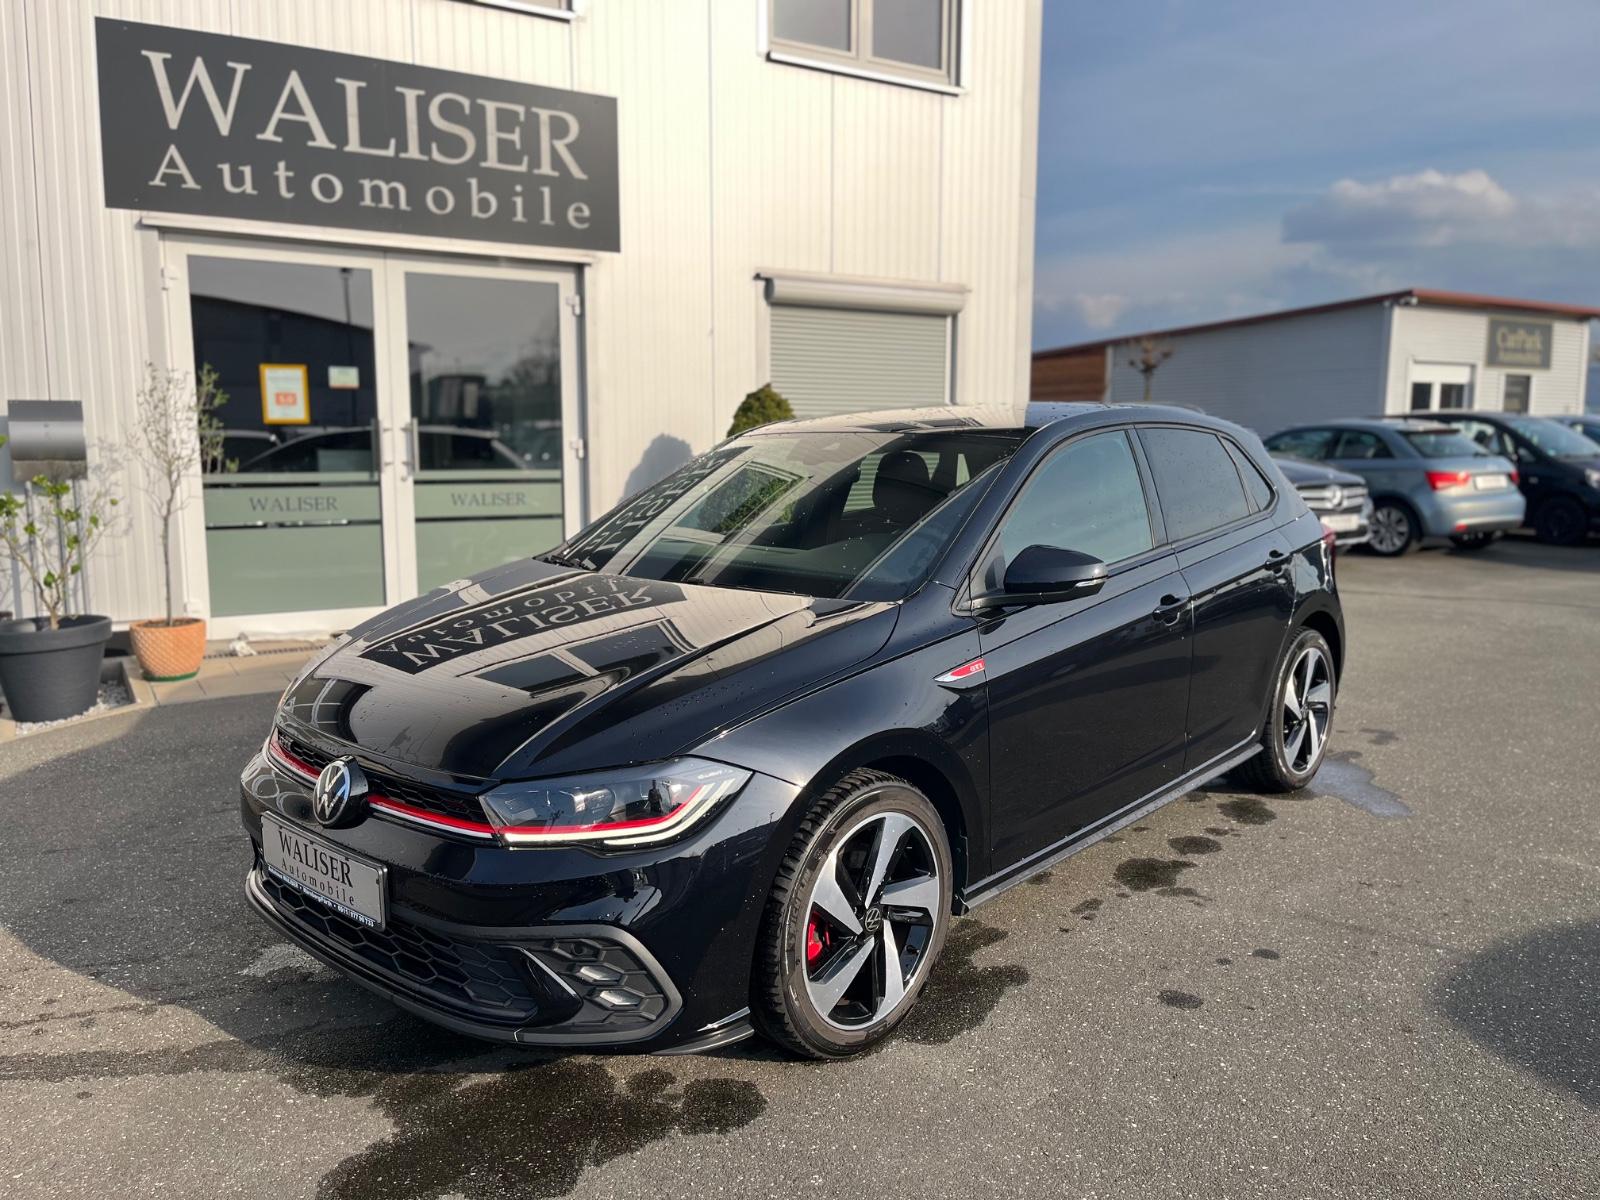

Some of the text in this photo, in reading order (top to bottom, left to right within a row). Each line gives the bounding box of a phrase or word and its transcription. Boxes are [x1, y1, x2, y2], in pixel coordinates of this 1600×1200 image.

[141, 50, 588, 180] WALISER
[149, 144, 590, 229] Automobile
[249, 496, 338, 512] WALISER
[451, 491, 527, 507] WALISER
[279, 830, 353, 888] WALISER
[282, 858, 354, 905] Automobile
